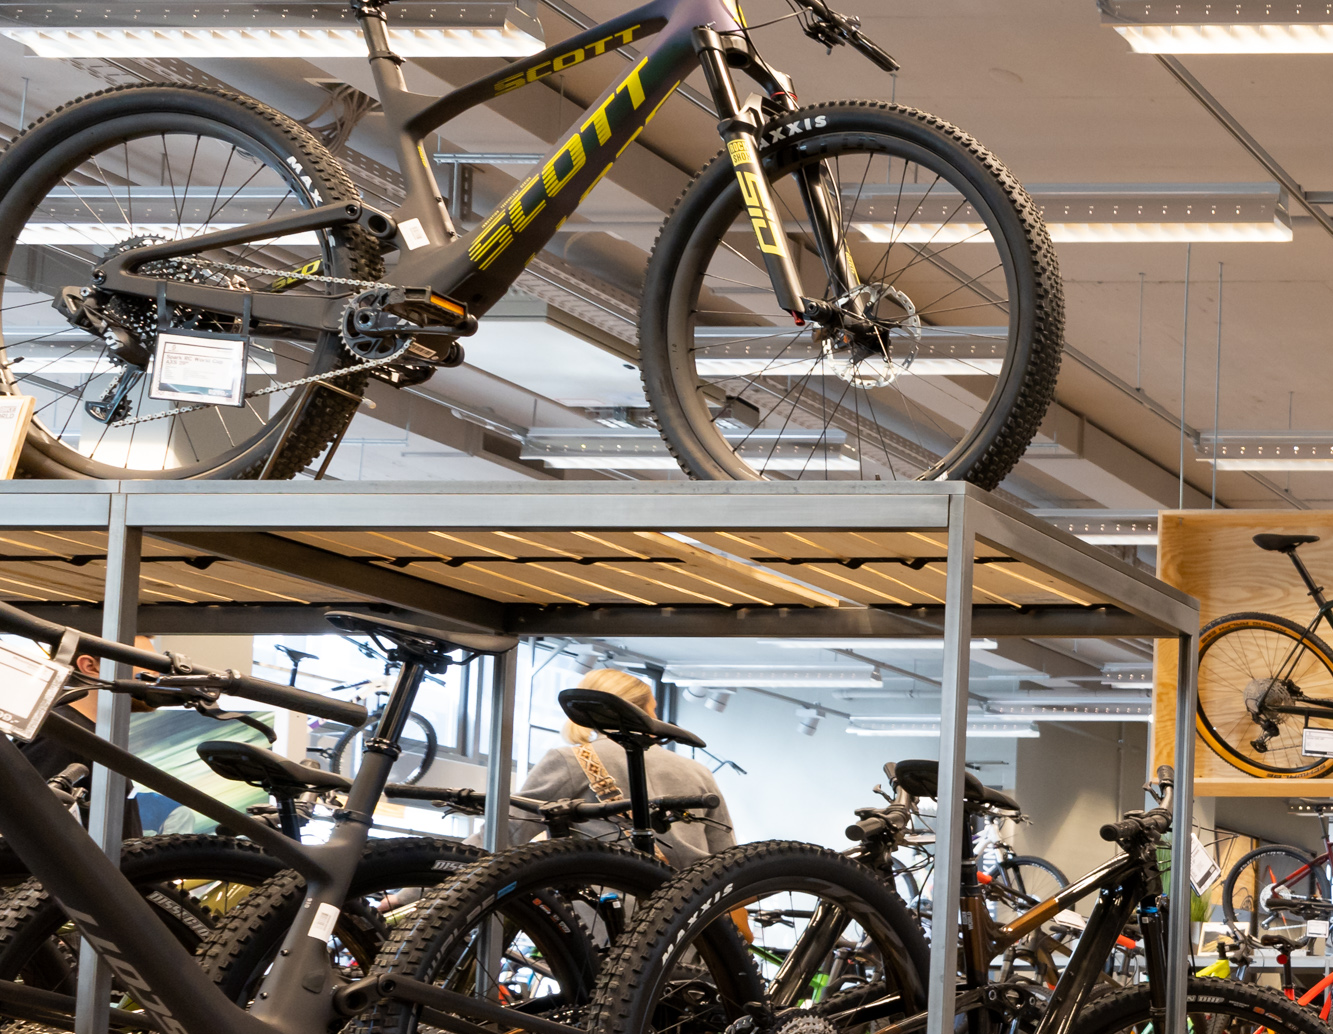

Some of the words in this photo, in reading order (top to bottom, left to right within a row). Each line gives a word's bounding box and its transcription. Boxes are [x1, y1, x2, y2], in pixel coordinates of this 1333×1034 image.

[494, 24, 641, 97] SCOTT
[468, 55, 648, 271] SCOTT
[735, 170, 788, 259] SID
[661, 882, 734, 967] MAXXIS
